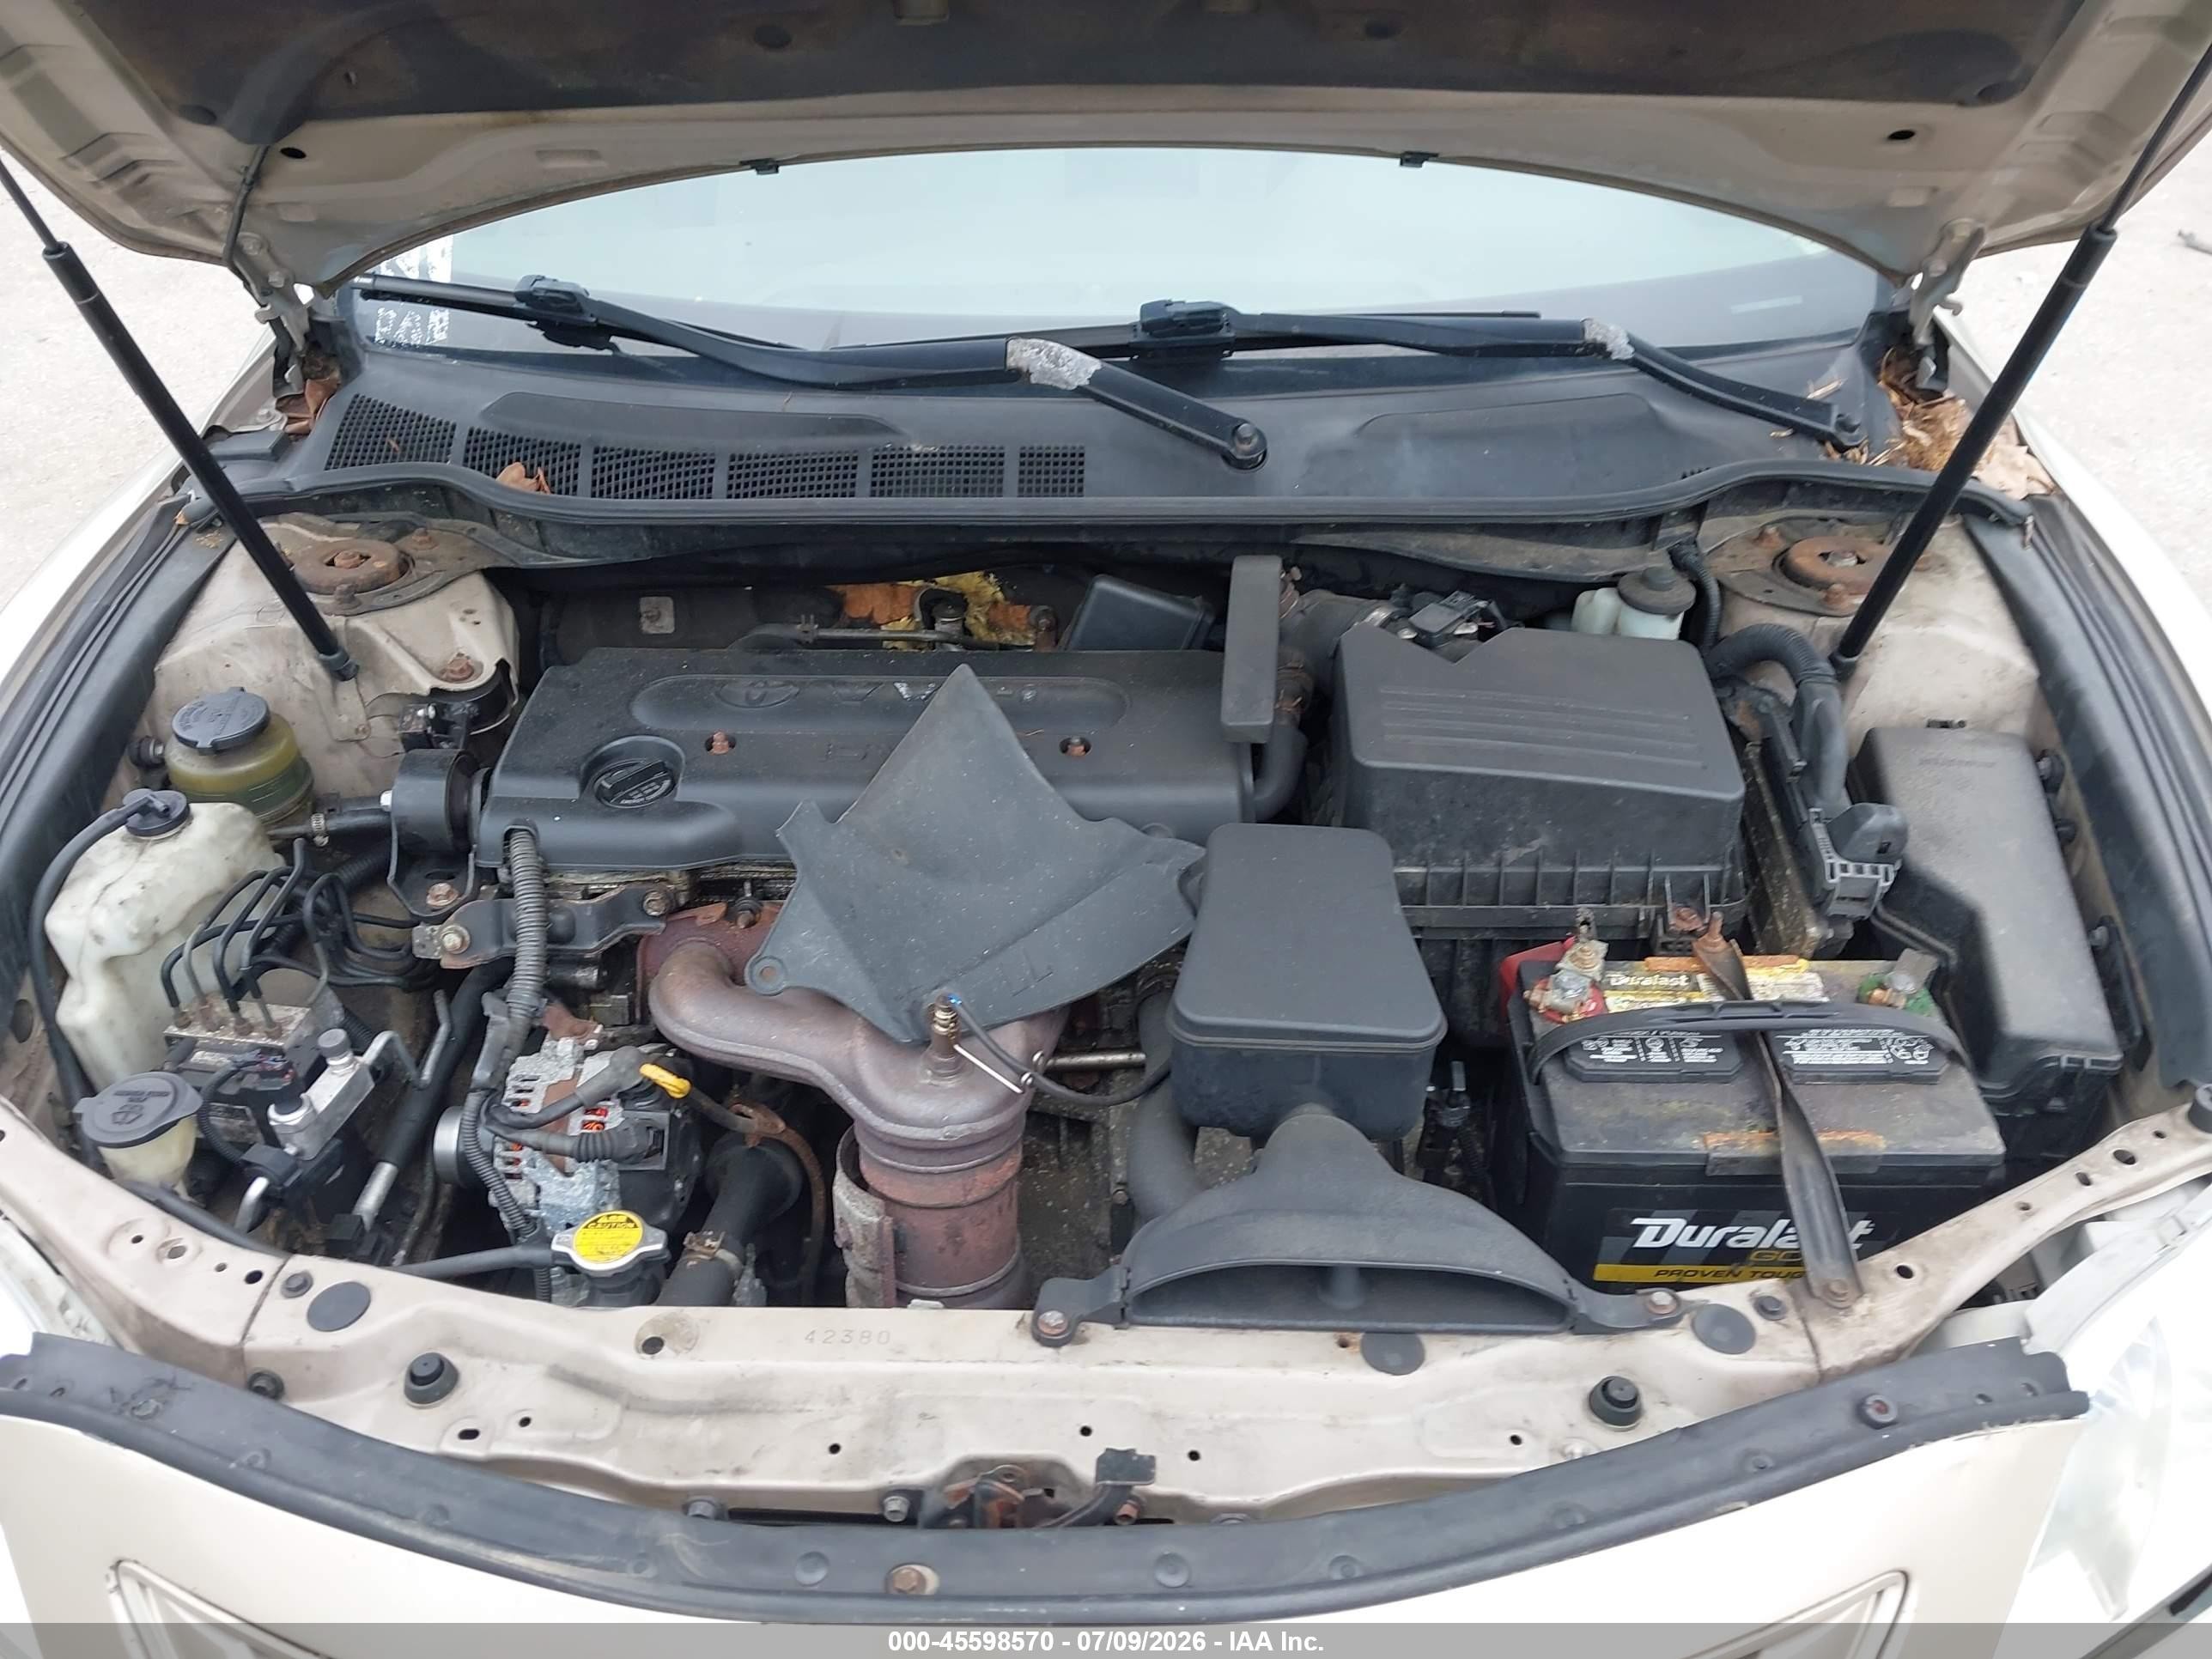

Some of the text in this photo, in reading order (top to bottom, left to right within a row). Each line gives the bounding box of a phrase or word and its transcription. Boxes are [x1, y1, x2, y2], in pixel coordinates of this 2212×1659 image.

[1632, 1217, 1875, 1250] Duralat
[1654, 1269, 1807, 1279] PROVEN TOUG
[804, 1328, 891, 1346] 42380
